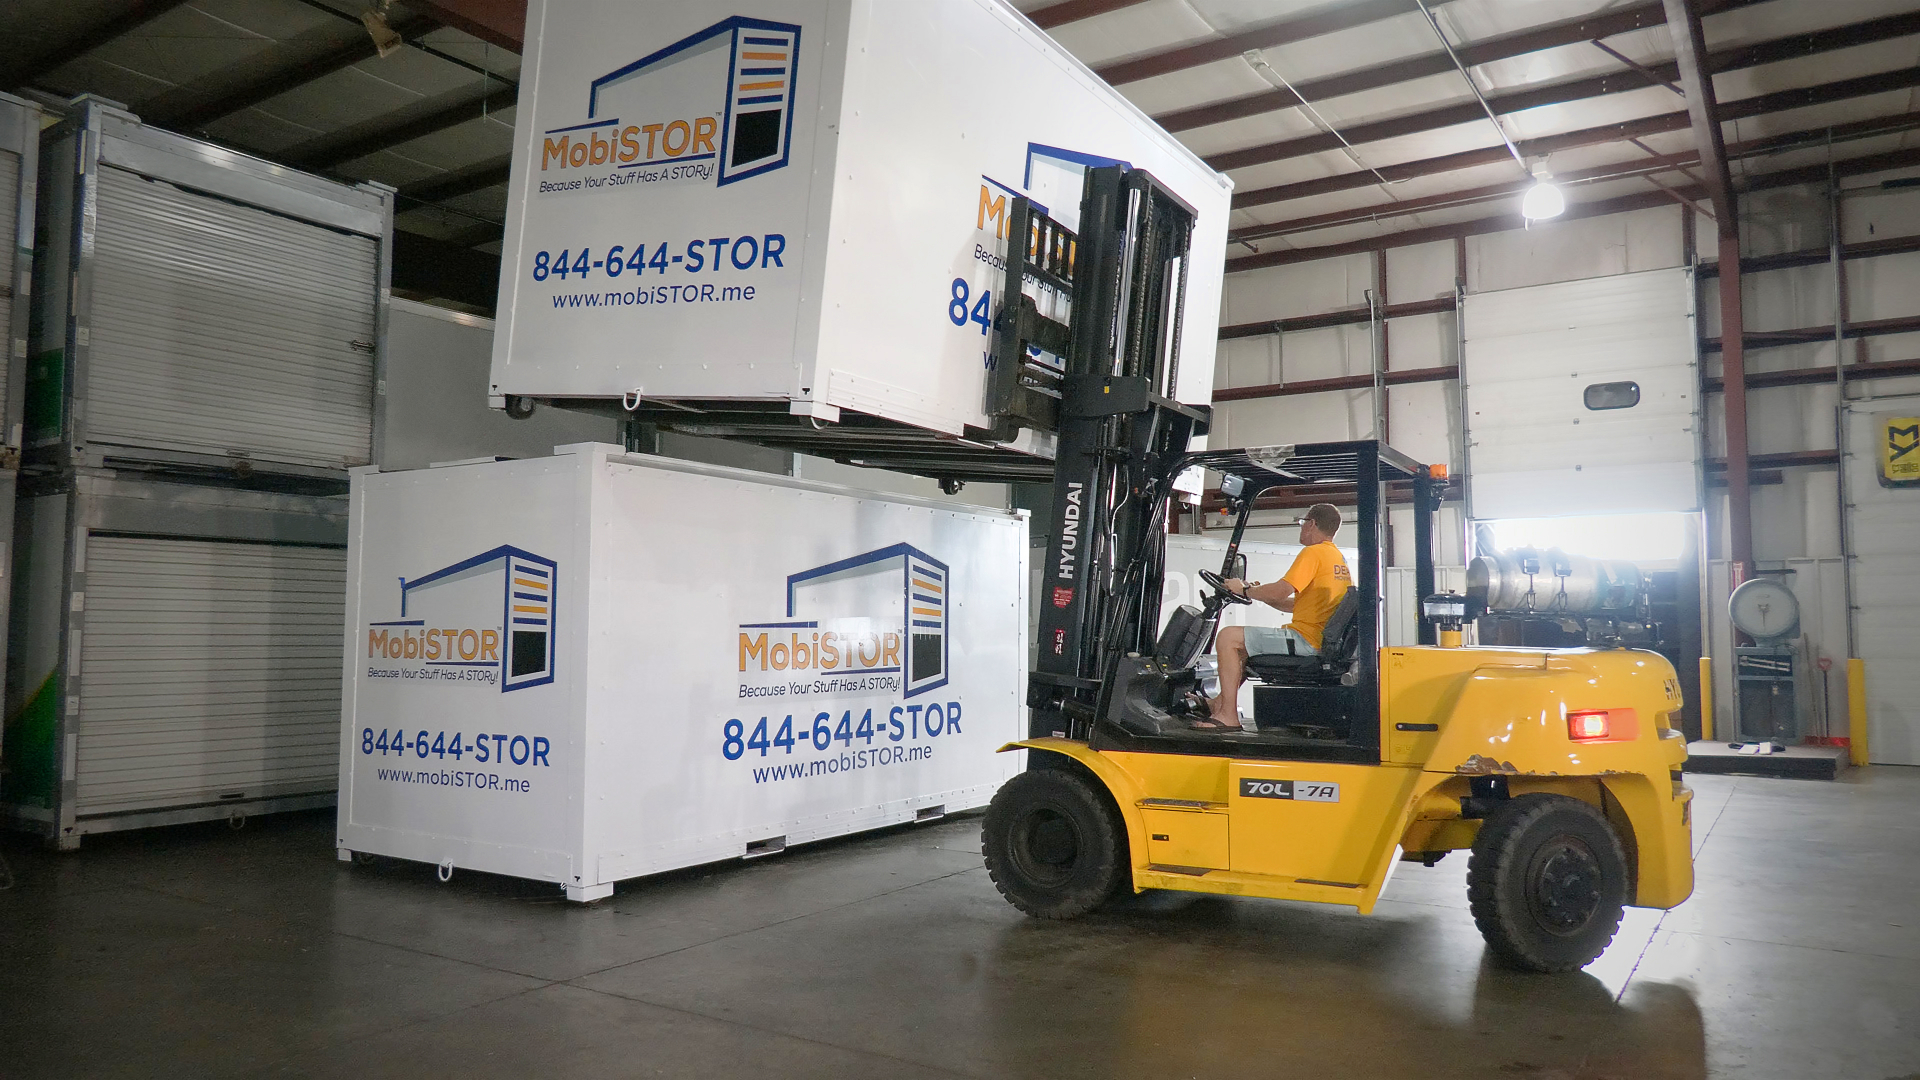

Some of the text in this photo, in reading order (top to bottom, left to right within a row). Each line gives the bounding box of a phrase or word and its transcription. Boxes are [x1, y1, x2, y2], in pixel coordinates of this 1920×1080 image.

[541, 116, 718, 171] MobiSTOR
[539, 163, 715, 193] Because Your Stuff Has A STORy!
[532, 233, 786, 282] 844-644-STOR
[552, 283, 756, 309] www.mobiSTOR.me
[1058, 482, 1083, 580] HYUNDAI
[368, 628, 499, 661] MobiSTOR
[738, 631, 901, 672] MobiSTOR
[367, 666, 499, 685] Because Your Stuff Has A STORy!
[739, 676, 901, 698] Because Your Stuff Has A STORy!
[361, 727, 550, 767] 844-644-STOR
[722, 700, 962, 761] 844-644-STOR
[377, 768, 531, 793] www.mobiSTOR.me
[752, 744, 932, 784] www.mobiSTOR.me
